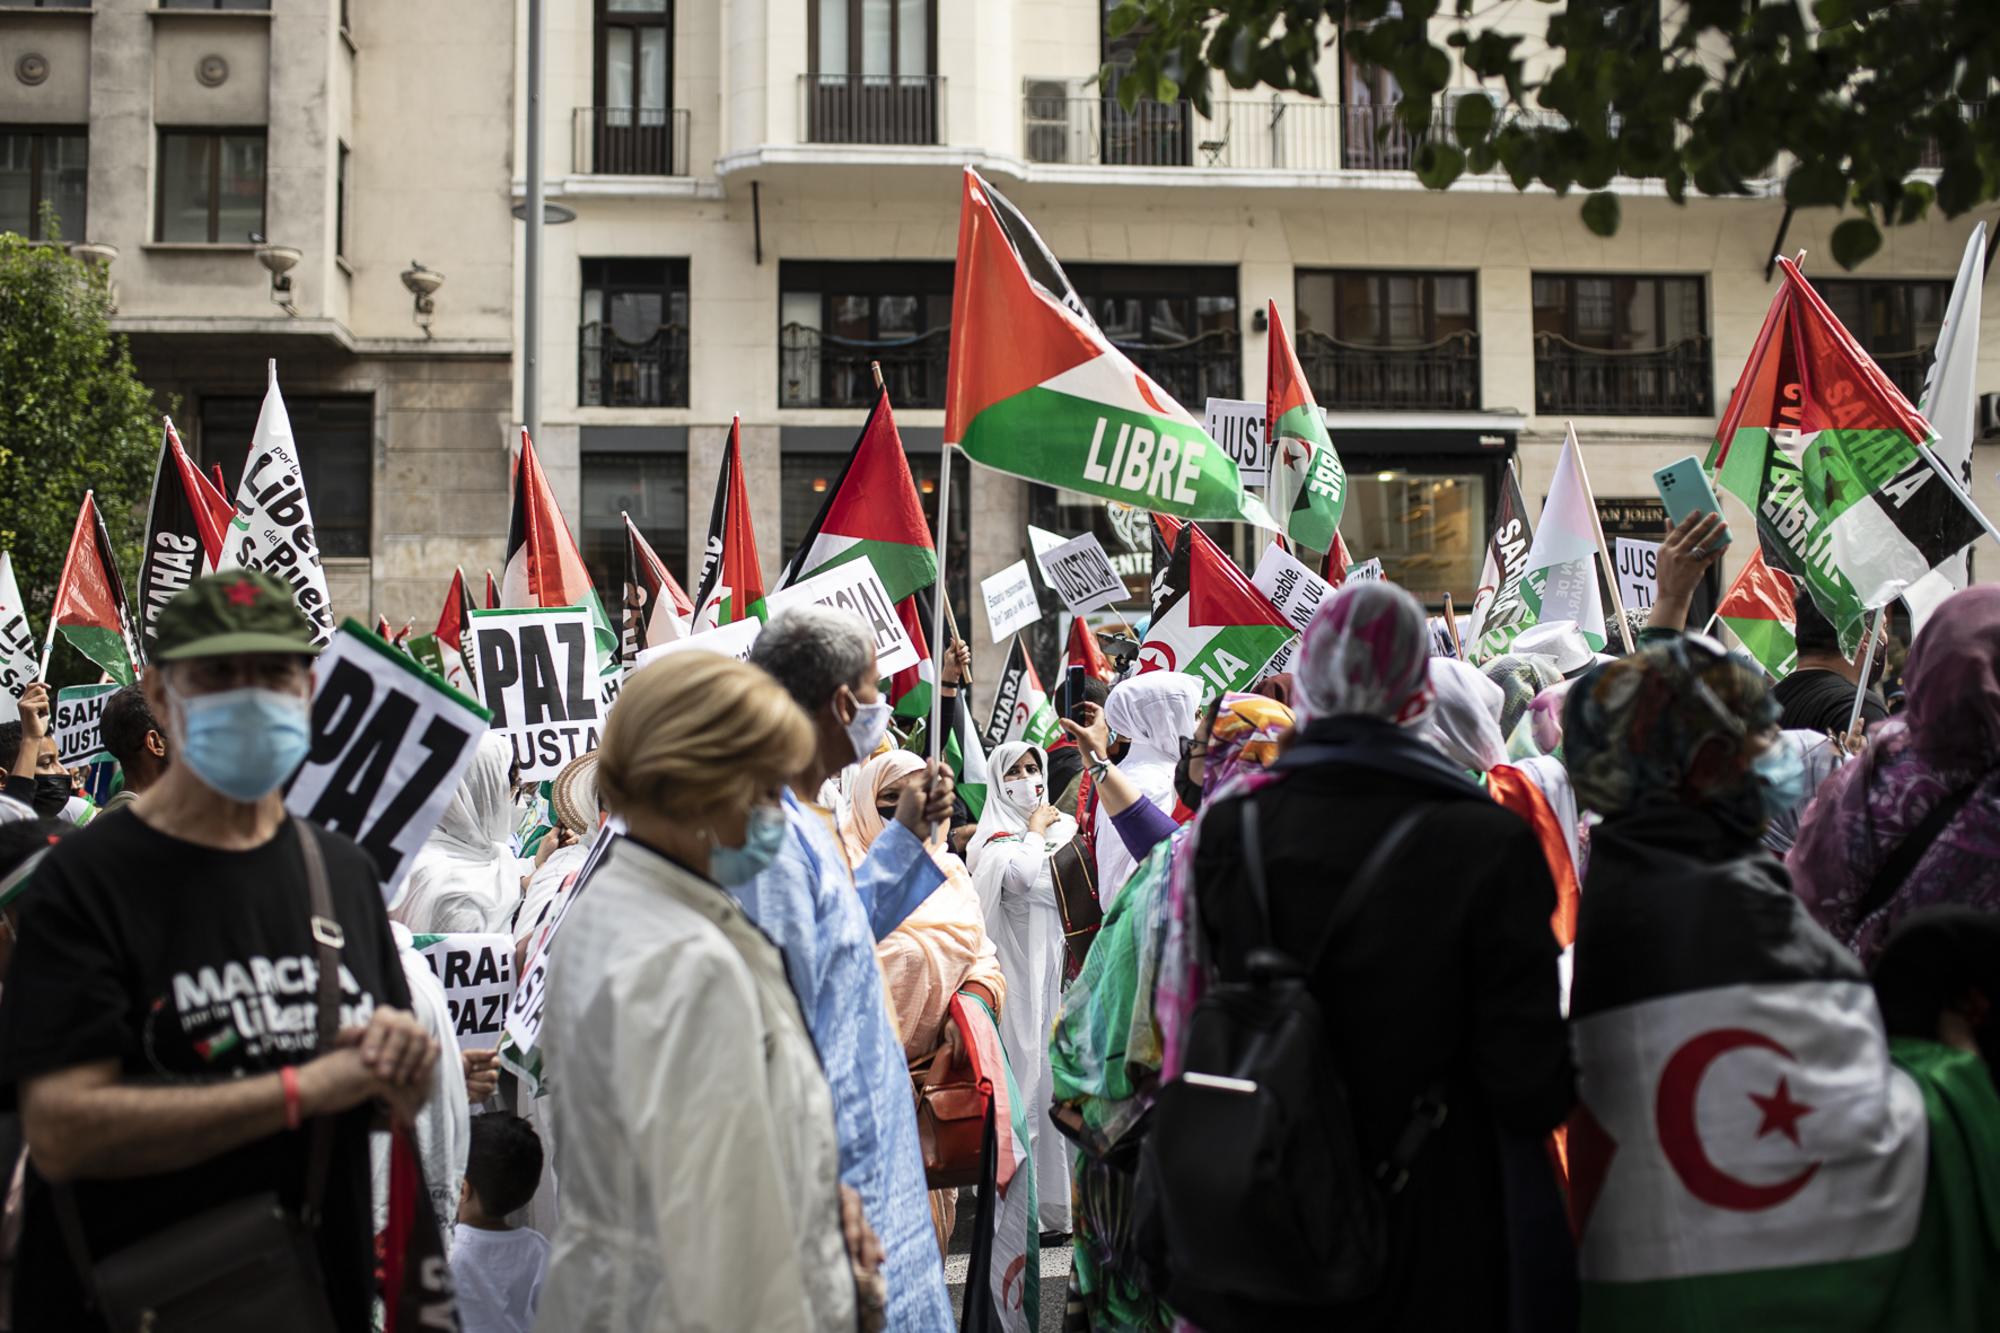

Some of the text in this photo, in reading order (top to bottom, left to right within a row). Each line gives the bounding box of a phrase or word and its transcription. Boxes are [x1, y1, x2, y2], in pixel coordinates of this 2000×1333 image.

[270, 446, 292, 465] por
[1083, 416, 1206, 506] LIBRE
[264, 528, 284, 548] del
[1620, 547, 1657, 580] JUS
[477, 622, 598, 730] PAZ
[57, 696, 111, 730] SAH
[988, 669, 1021, 746] AHARA
[283, 656, 471, 884] PAZ
[508, 727, 602, 770] USTA
